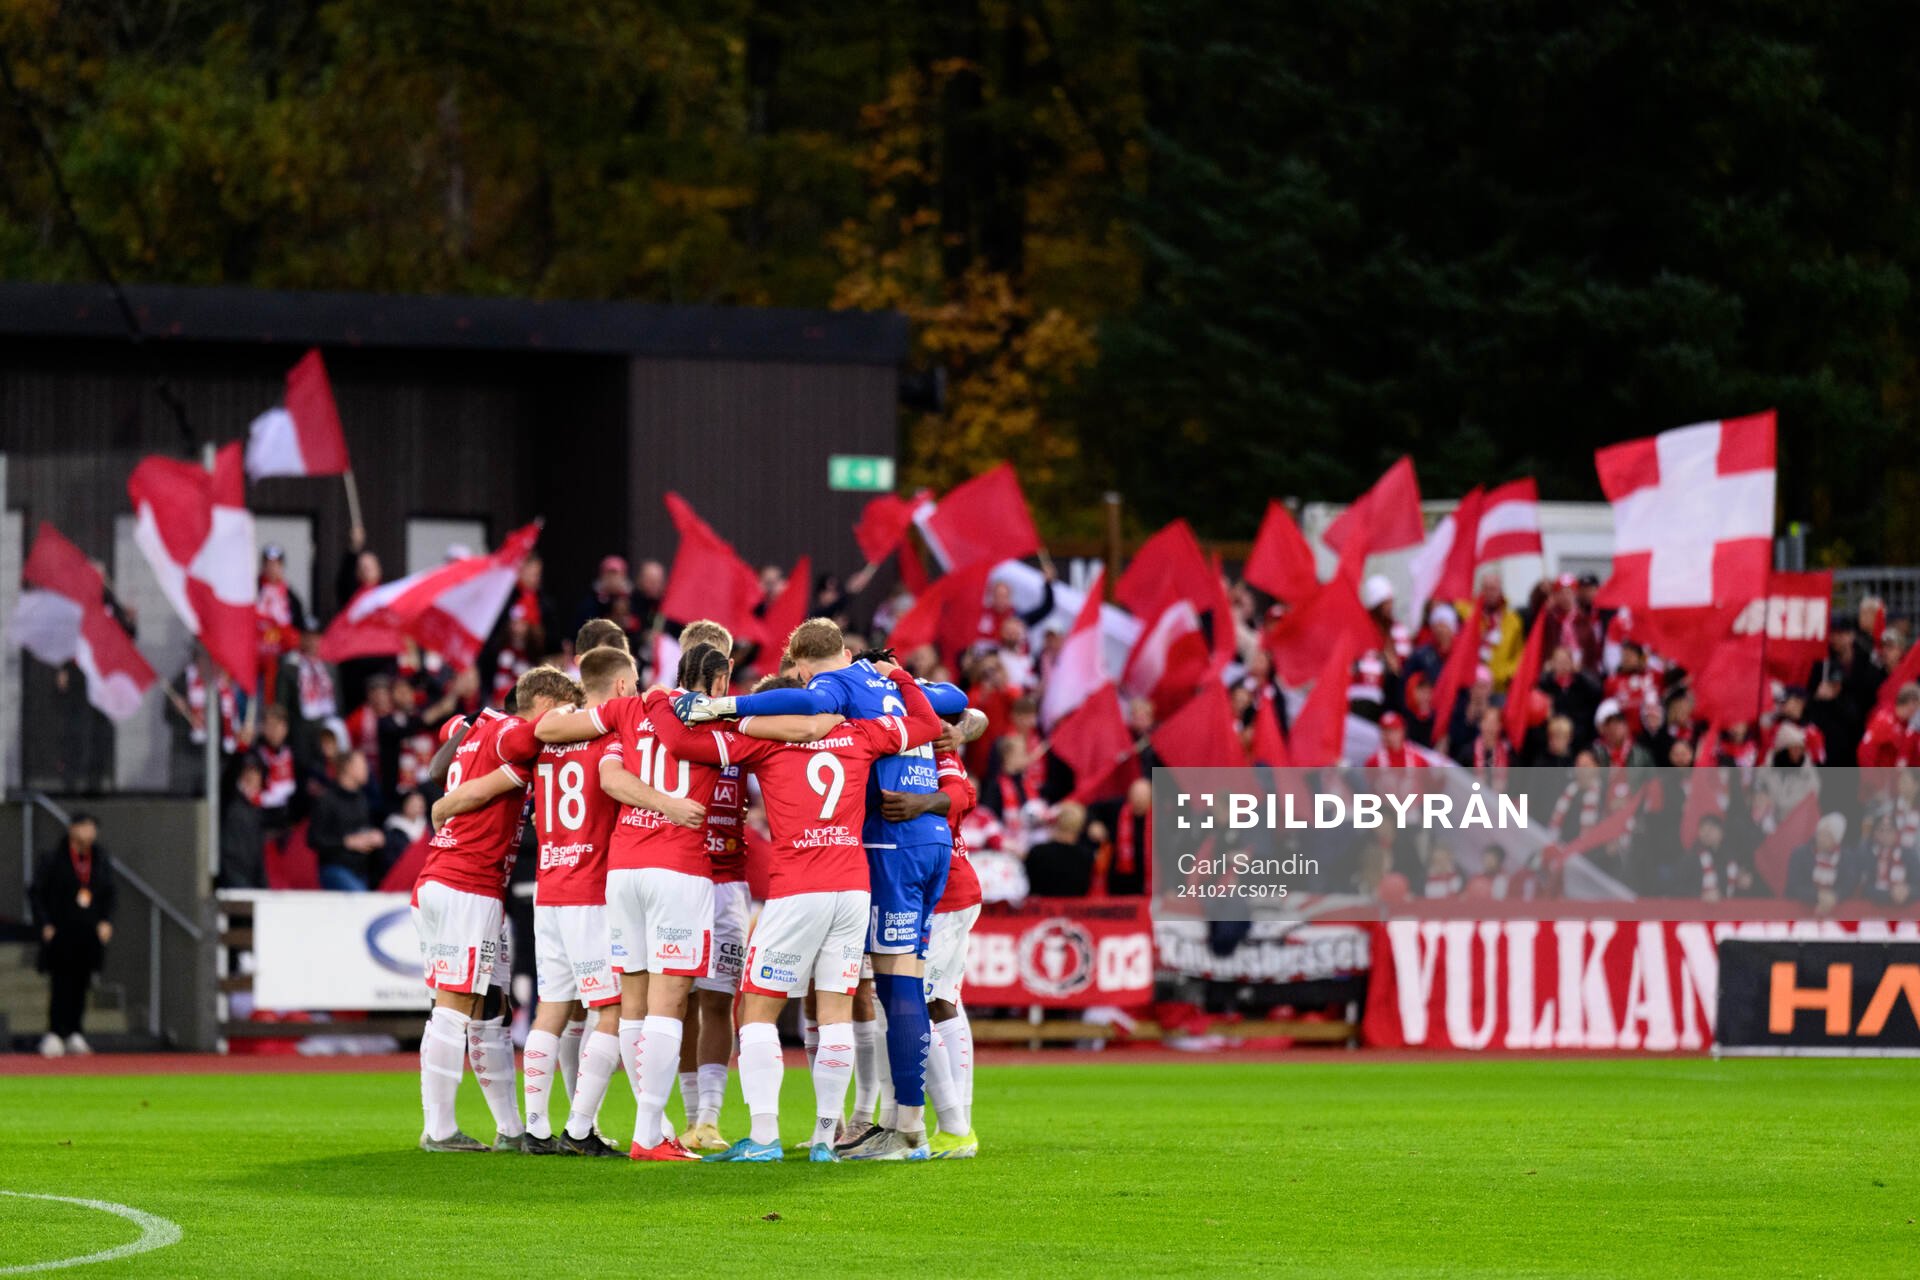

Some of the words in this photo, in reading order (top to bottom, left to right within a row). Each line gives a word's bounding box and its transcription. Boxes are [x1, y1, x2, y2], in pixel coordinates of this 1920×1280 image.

[636, 737, 690, 799] 10
[907, 765, 935, 778] NORDIC
[806, 751, 845, 819] 9
[537, 761, 587, 833] 18
[804, 826, 850, 839] NORDIC
[792, 836, 859, 848] WELLNESS
[885, 911, 918, 920] factoring
[885, 919, 915, 927] gruppen
[656, 925, 692, 935] factoring
[663, 944, 681, 954] ICA
[765, 948, 802, 961] factoring
[582, 977, 600, 987] ICA
[773, 974, 798, 983] HALLEN
